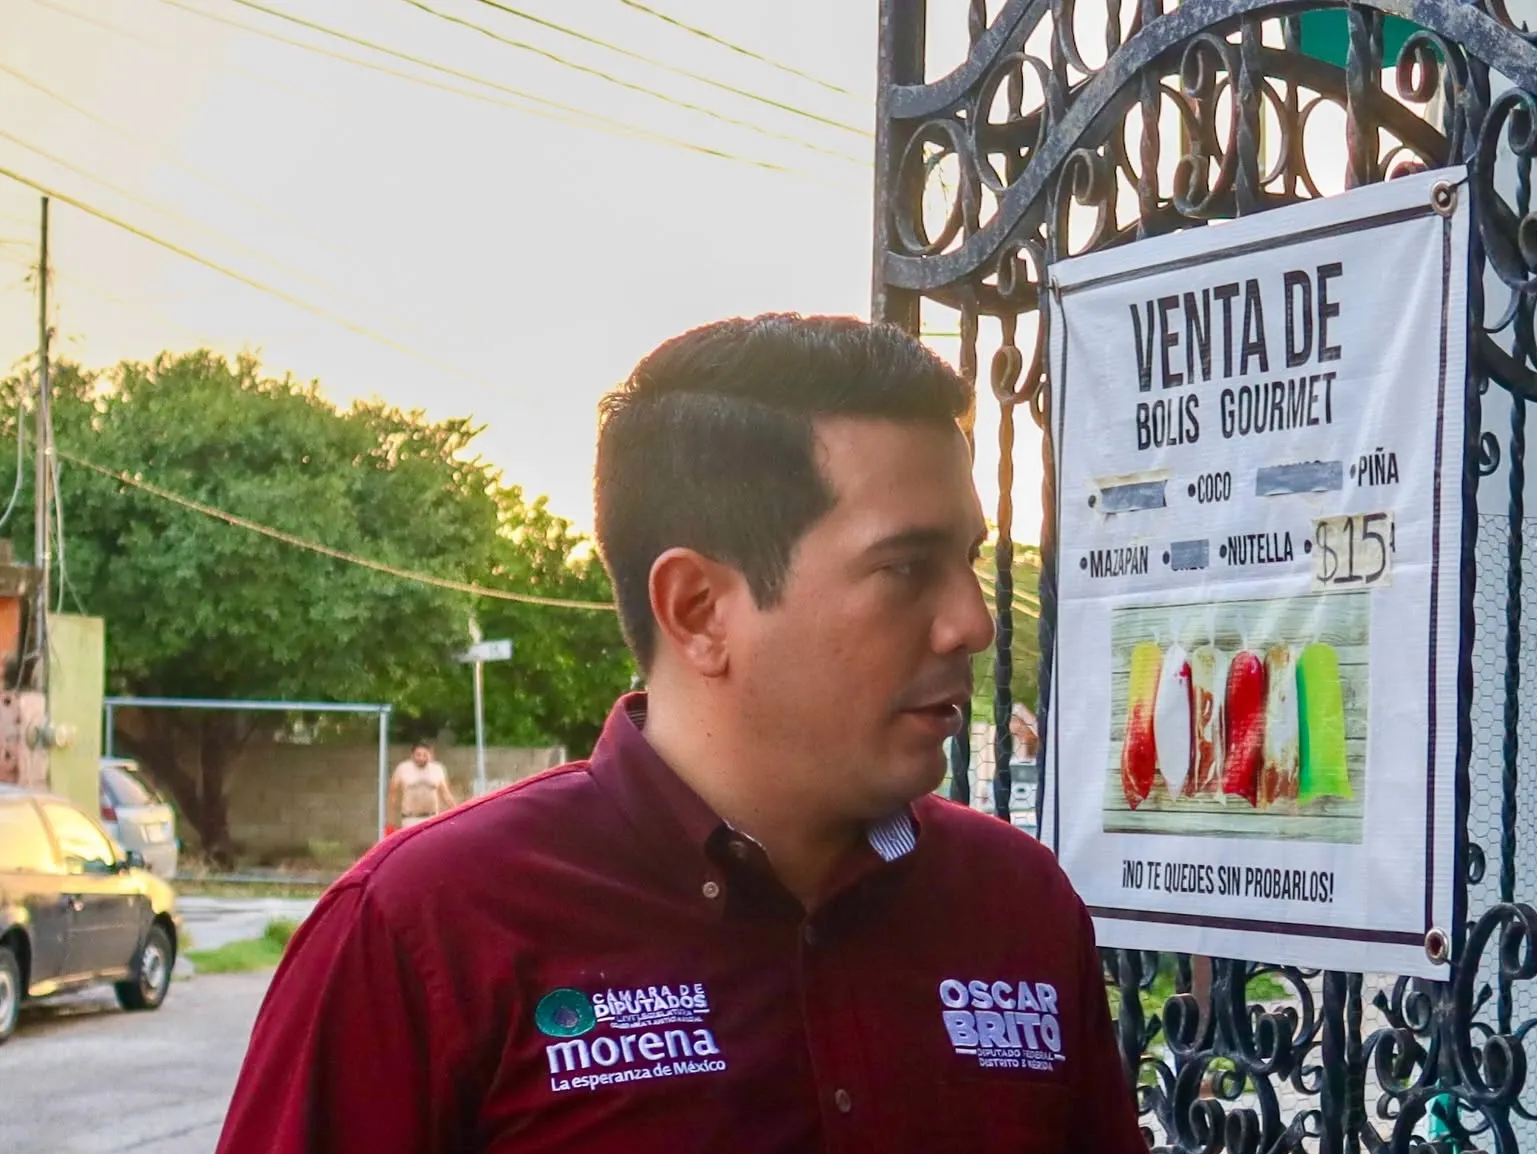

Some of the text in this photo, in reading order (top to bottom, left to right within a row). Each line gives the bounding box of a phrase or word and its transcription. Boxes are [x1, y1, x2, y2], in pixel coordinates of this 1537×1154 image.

[1130, 262, 1343, 392] VENTA DE
[1136, 372, 1337, 450] BOLIS GOURMET
[1198, 471, 1231, 503] COCO
[1358, 447, 1399, 487] PIÑA
[1228, 531, 1294, 566] NUTELLA
[1315, 512, 1388, 586] $15
[1122, 859, 1334, 903] ¡NO TE QUEDES SIN PROBARLOS!
[592, 983, 705, 1004] CÁMARA DE
[593, 994, 708, 1019] DIPUTADOS
[939, 978, 1059, 1014] OSCAR
[545, 1027, 720, 1074] morena
[942, 1010, 1062, 1053] BRITO
[551, 1058, 726, 1092] La esperanza de México
